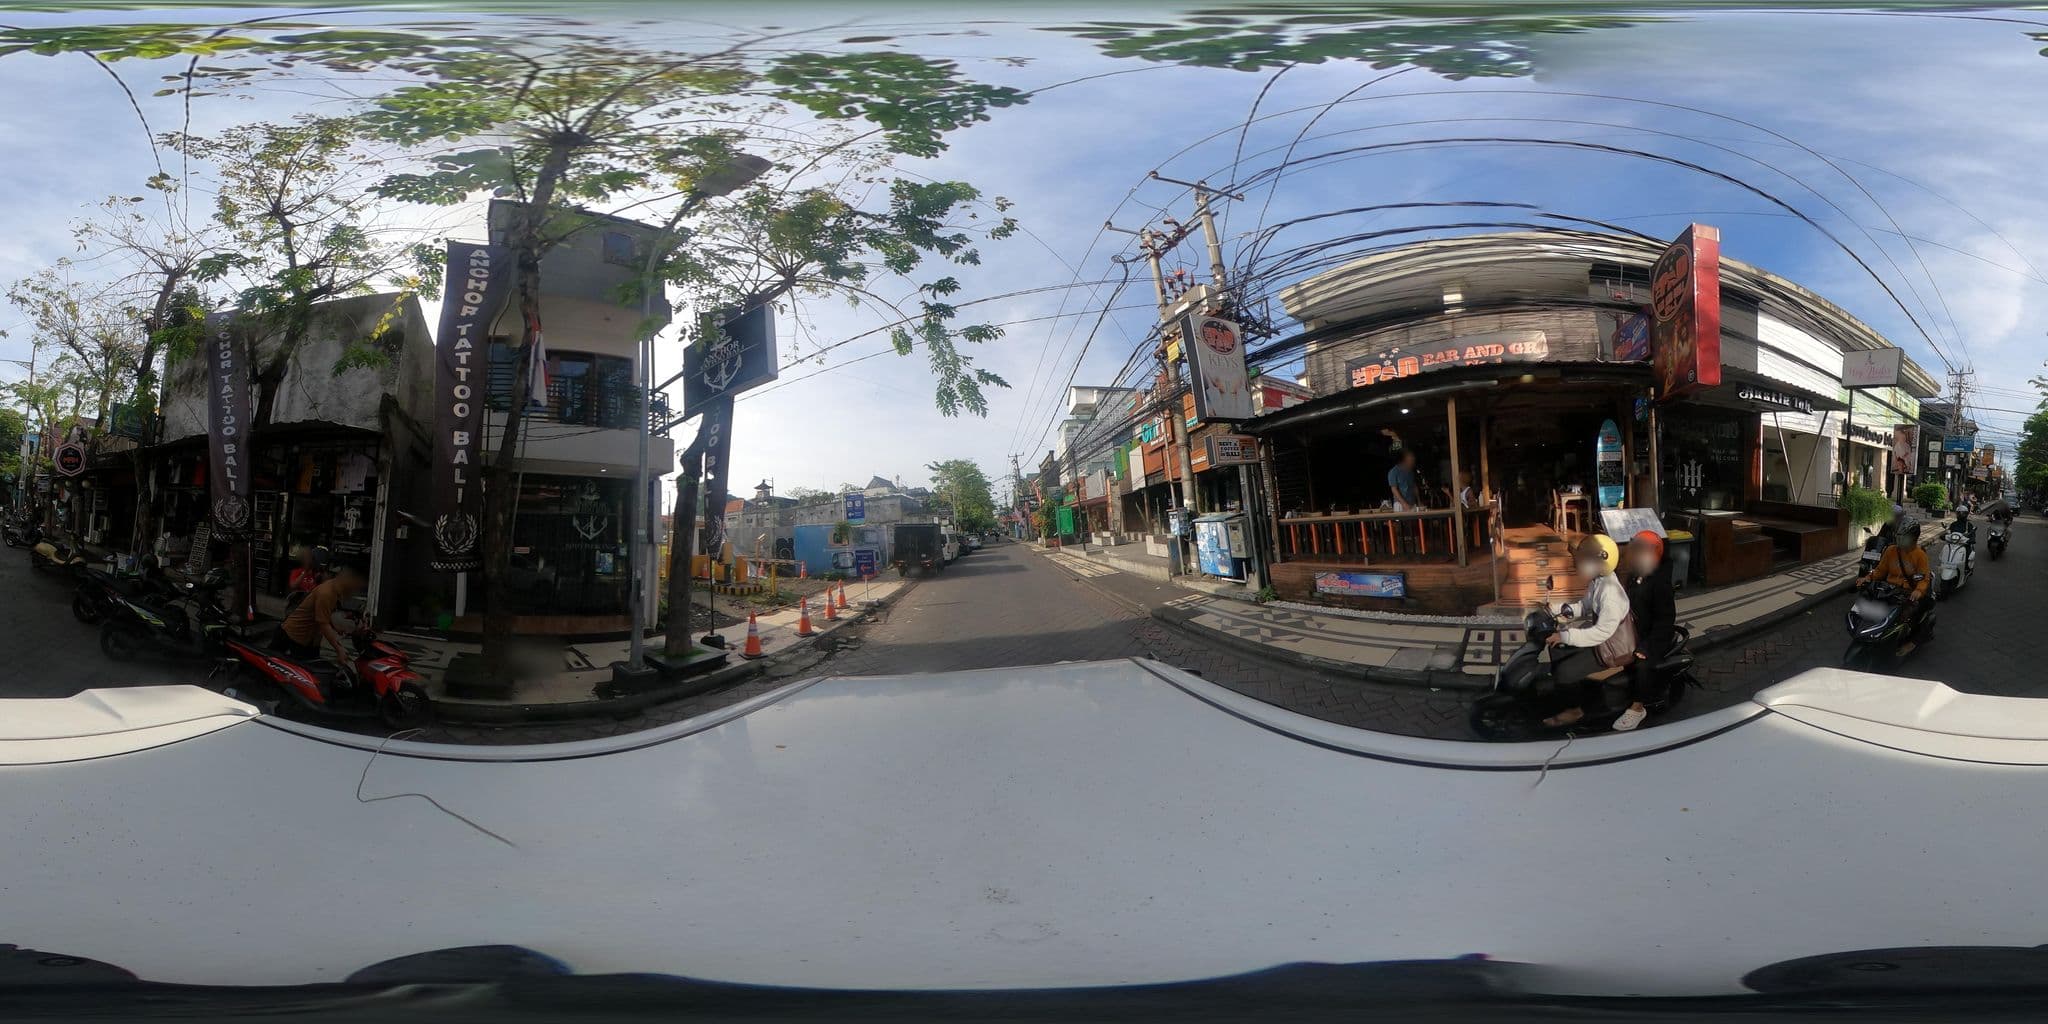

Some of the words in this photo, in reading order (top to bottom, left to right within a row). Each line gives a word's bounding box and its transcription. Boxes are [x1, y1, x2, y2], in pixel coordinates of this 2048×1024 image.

[460, 249, 490, 316] ANCHOR
[454, 323, 473, 418] TATTOO
[1422, 349, 1460, 366] BAR
[1463, 343, 1505, 359] AND
[221, 374, 236, 436] TATTOO
[223, 444, 237, 491] BALI
[453, 431, 469, 503] BALI
